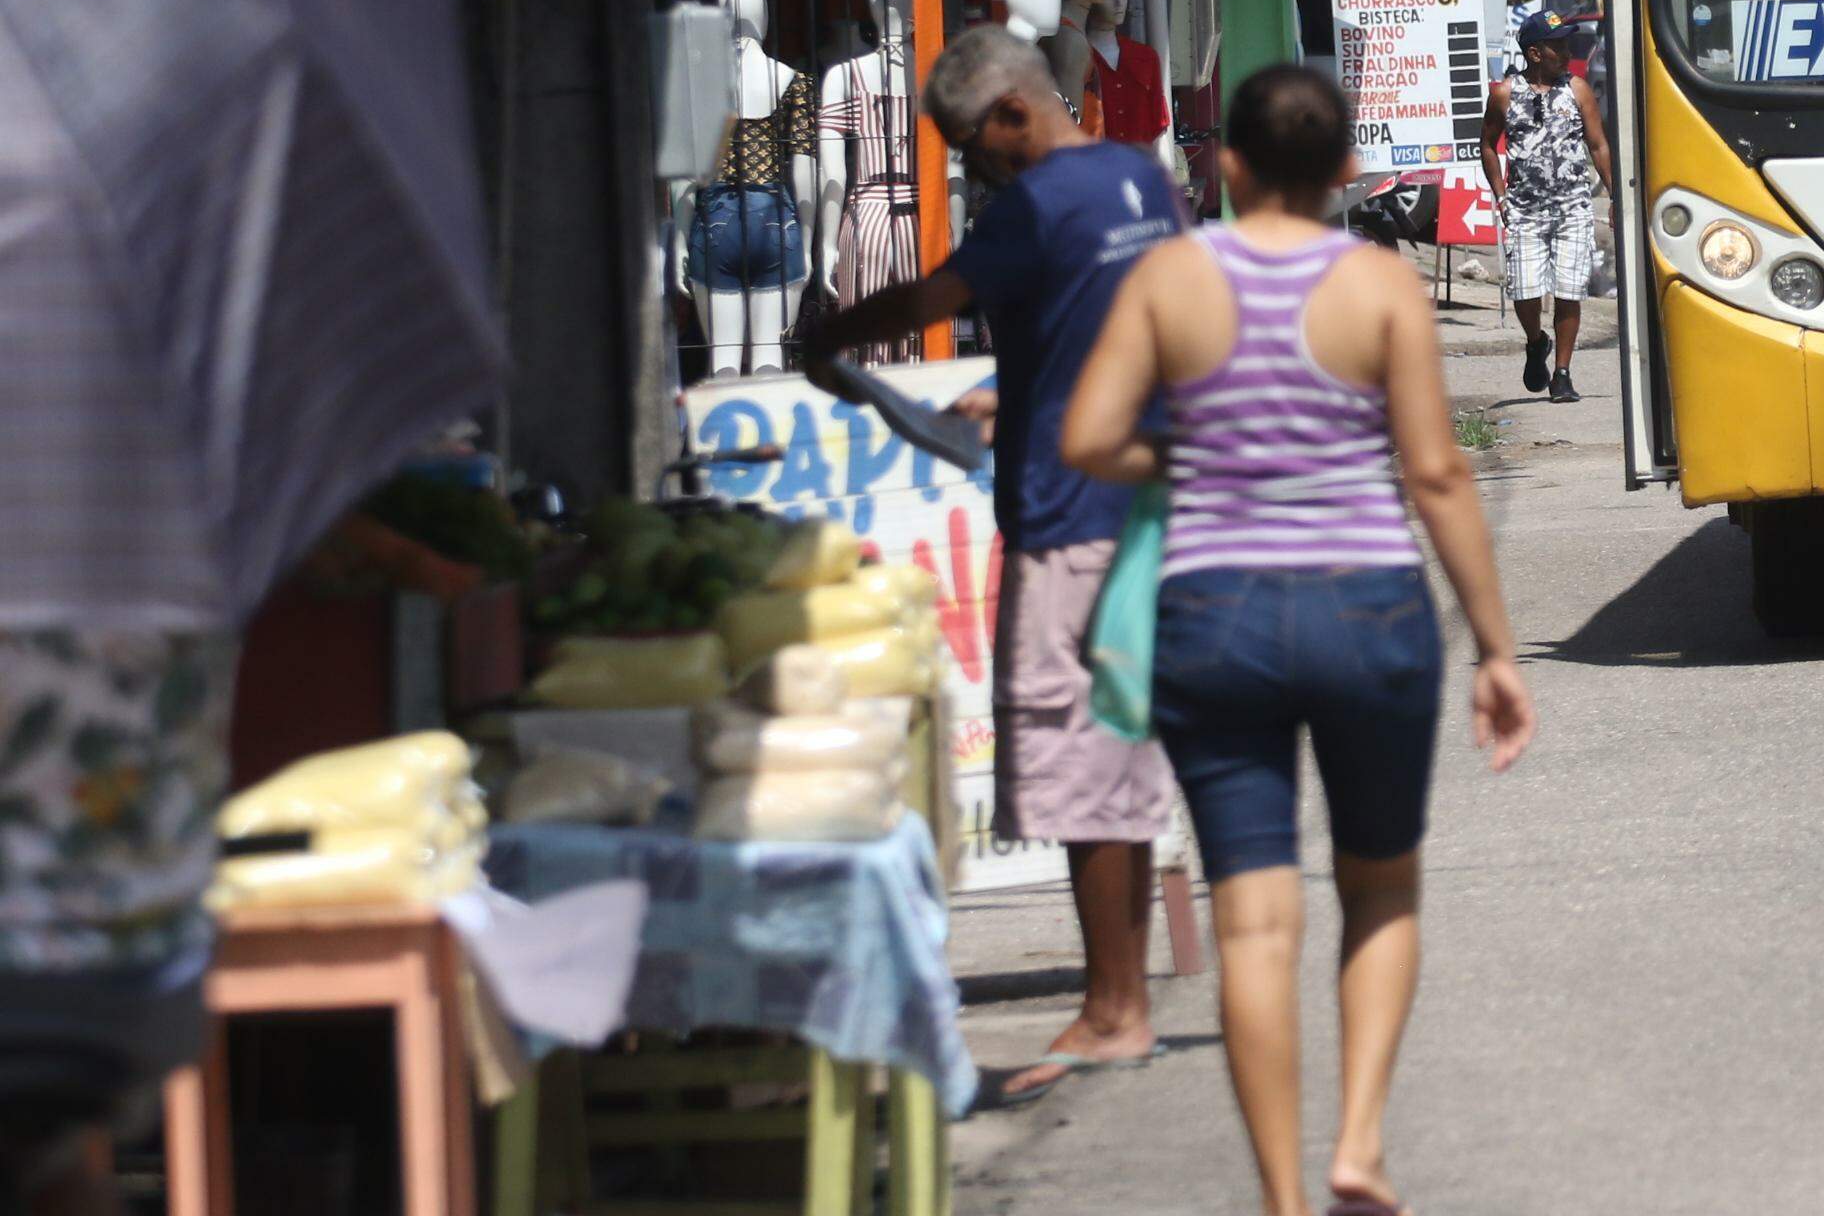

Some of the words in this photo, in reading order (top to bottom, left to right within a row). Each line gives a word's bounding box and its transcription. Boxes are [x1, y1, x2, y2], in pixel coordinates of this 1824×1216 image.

[1341, 25, 1405, 42] BOVINO
[1342, 41, 1395, 58] SUINO
[1344, 90, 1400, 106] HARQUE
[1350, 122, 1393, 146] SOPA
[1393, 148, 1420, 162] VISA
